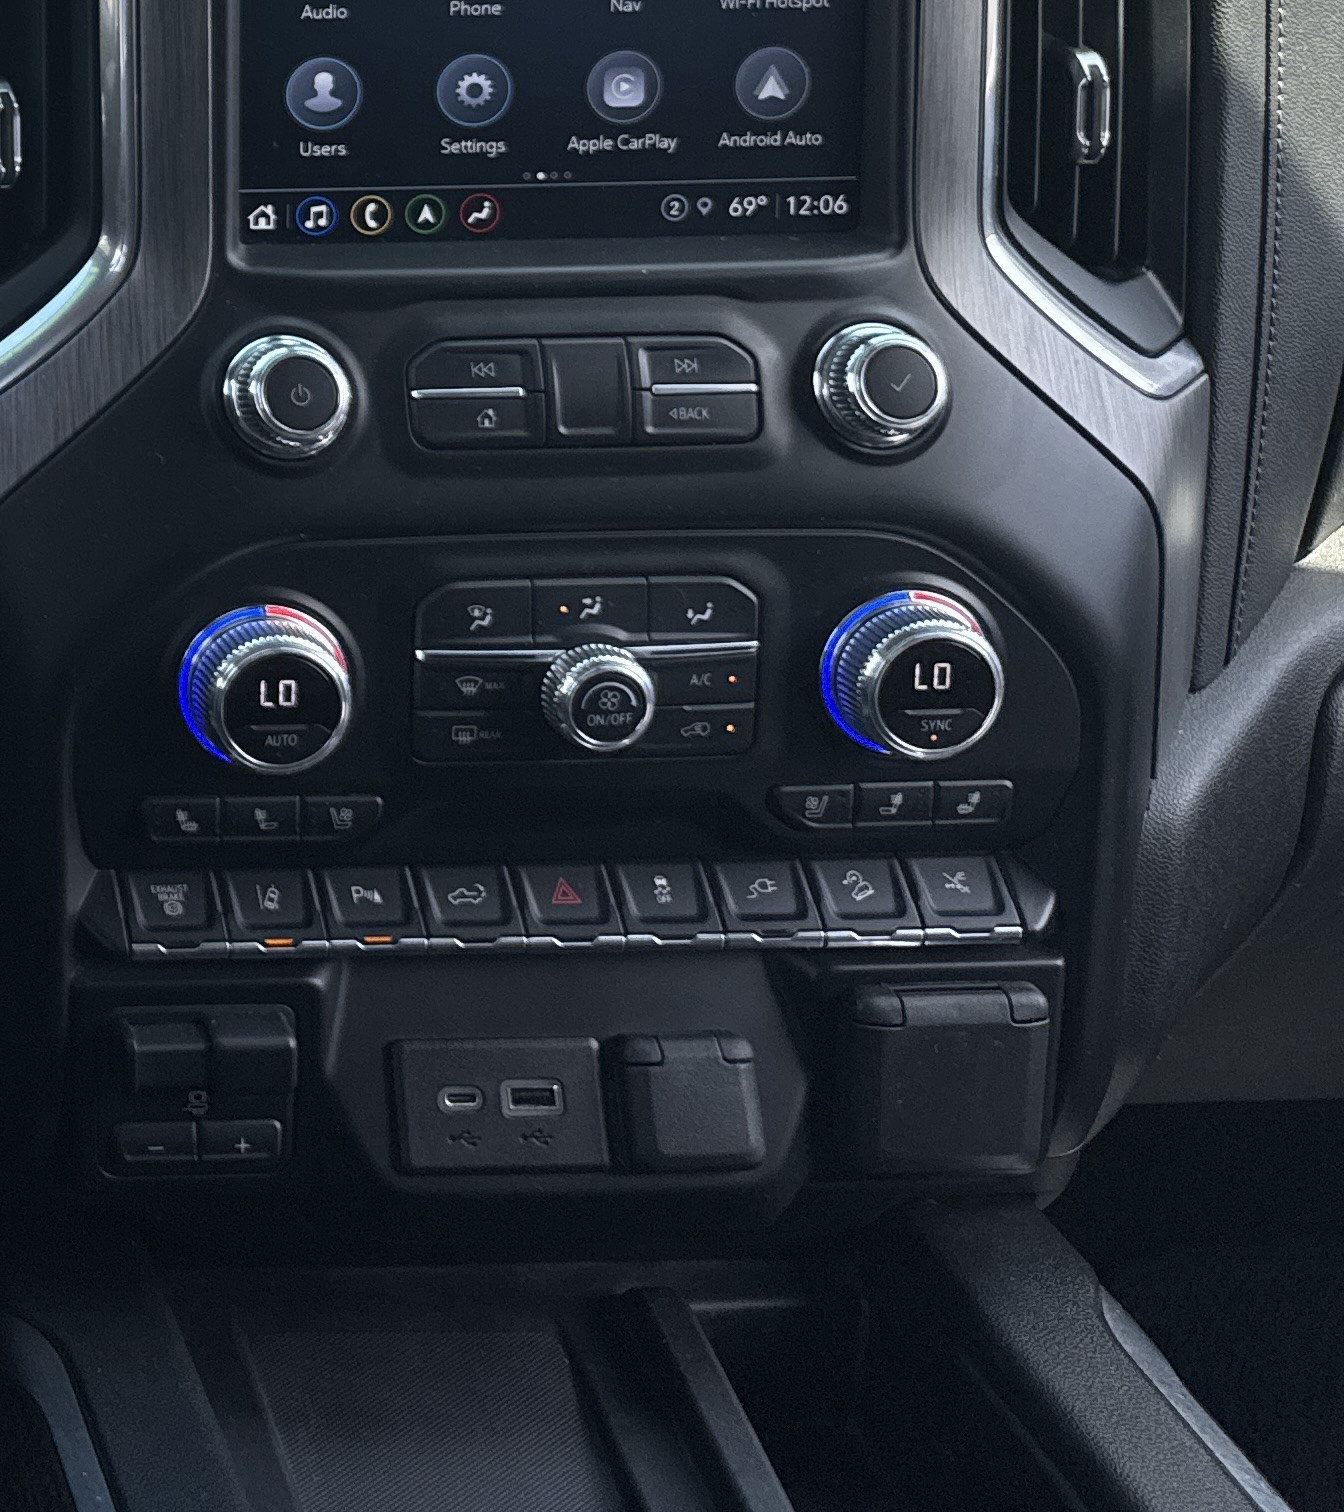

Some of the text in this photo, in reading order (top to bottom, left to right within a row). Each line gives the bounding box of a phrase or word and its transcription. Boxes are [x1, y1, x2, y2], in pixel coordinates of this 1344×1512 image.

[300, 4, 348, 20] Audio
[449, 0, 503, 17] Phone
[566, 133, 677, 154] Apple CarPlay
[717, 130, 823, 148] Android Auto
[299, 141, 347, 157] Users
[440, 138, 507, 158] Settings
[785, 194, 850, 216] 12:06
[679, 407, 710, 420] BACK
[690, 673, 712, 686] A/C
[914, 662, 952, 691] LO
[259, 679, 297, 708] LO
[586, 712, 634, 727] ON/OFF
[920, 718, 953, 732] SYNC
[264, 733, 298, 747] AUTO
